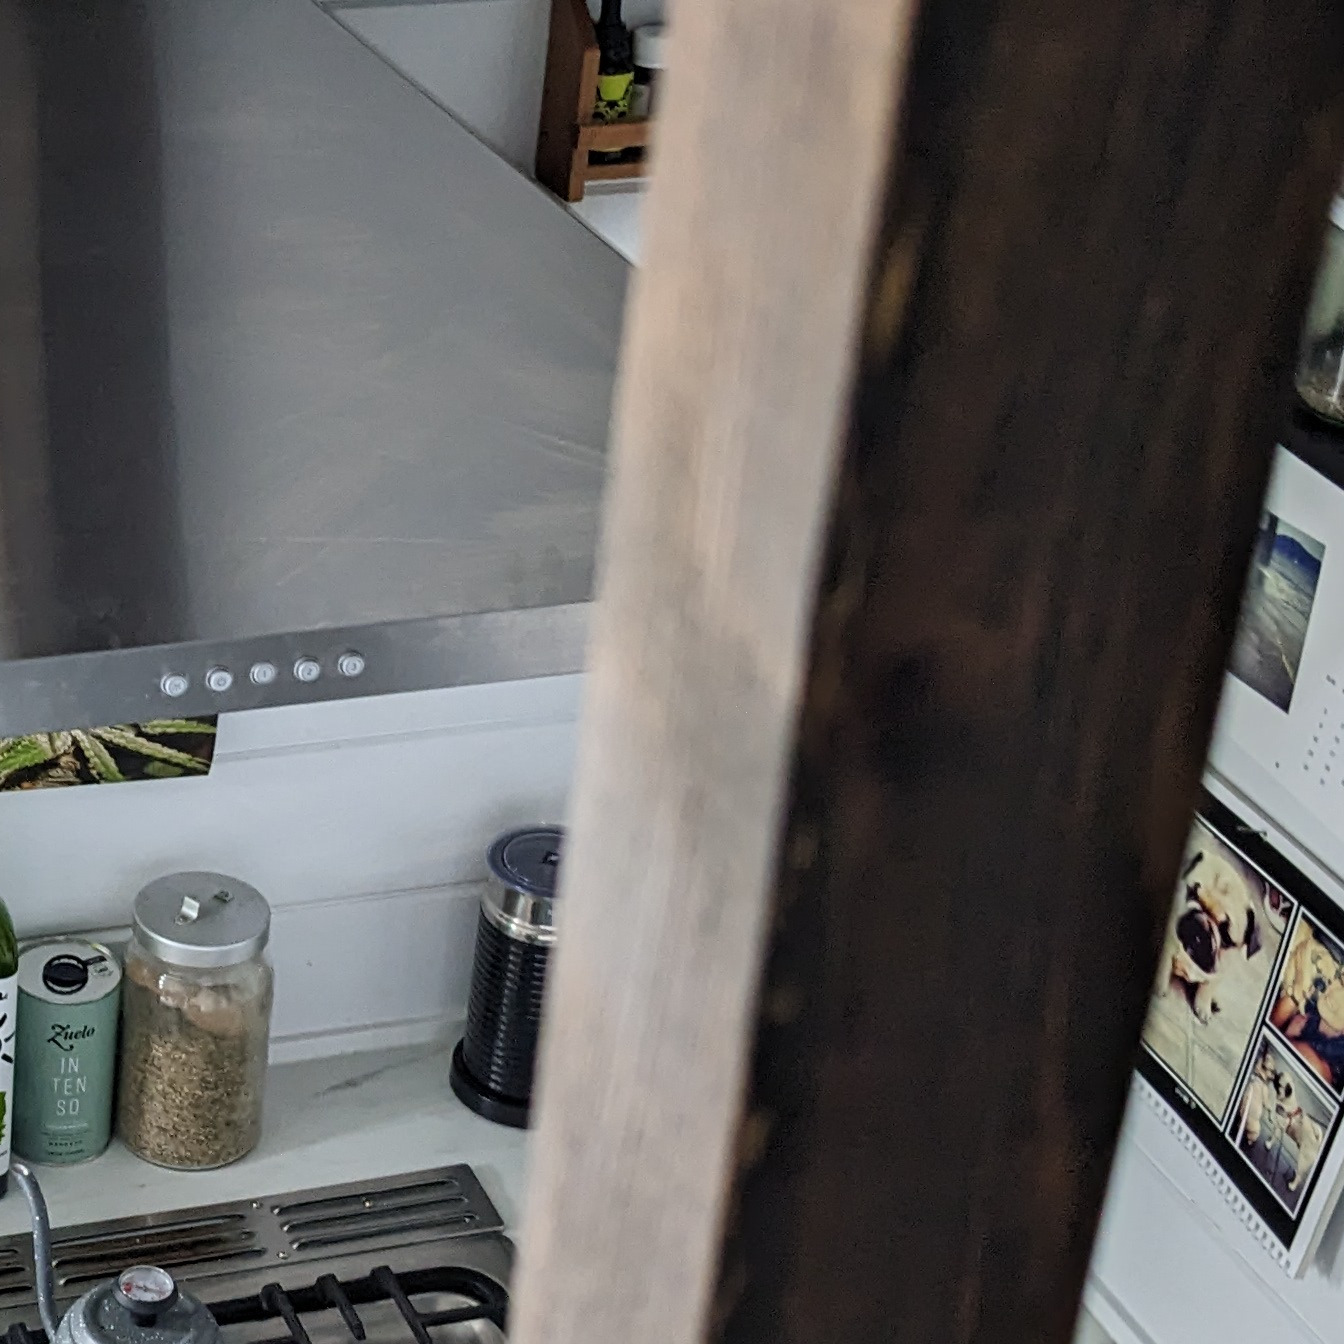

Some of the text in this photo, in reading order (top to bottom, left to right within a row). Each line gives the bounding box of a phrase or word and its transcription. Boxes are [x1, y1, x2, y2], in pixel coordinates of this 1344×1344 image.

[46, 1023, 95, 1052] Zuelo
[60, 1057, 79, 1074] IN
[52, 1076, 87, 1096] TEN
[57, 1099, 80, 1117] SO
